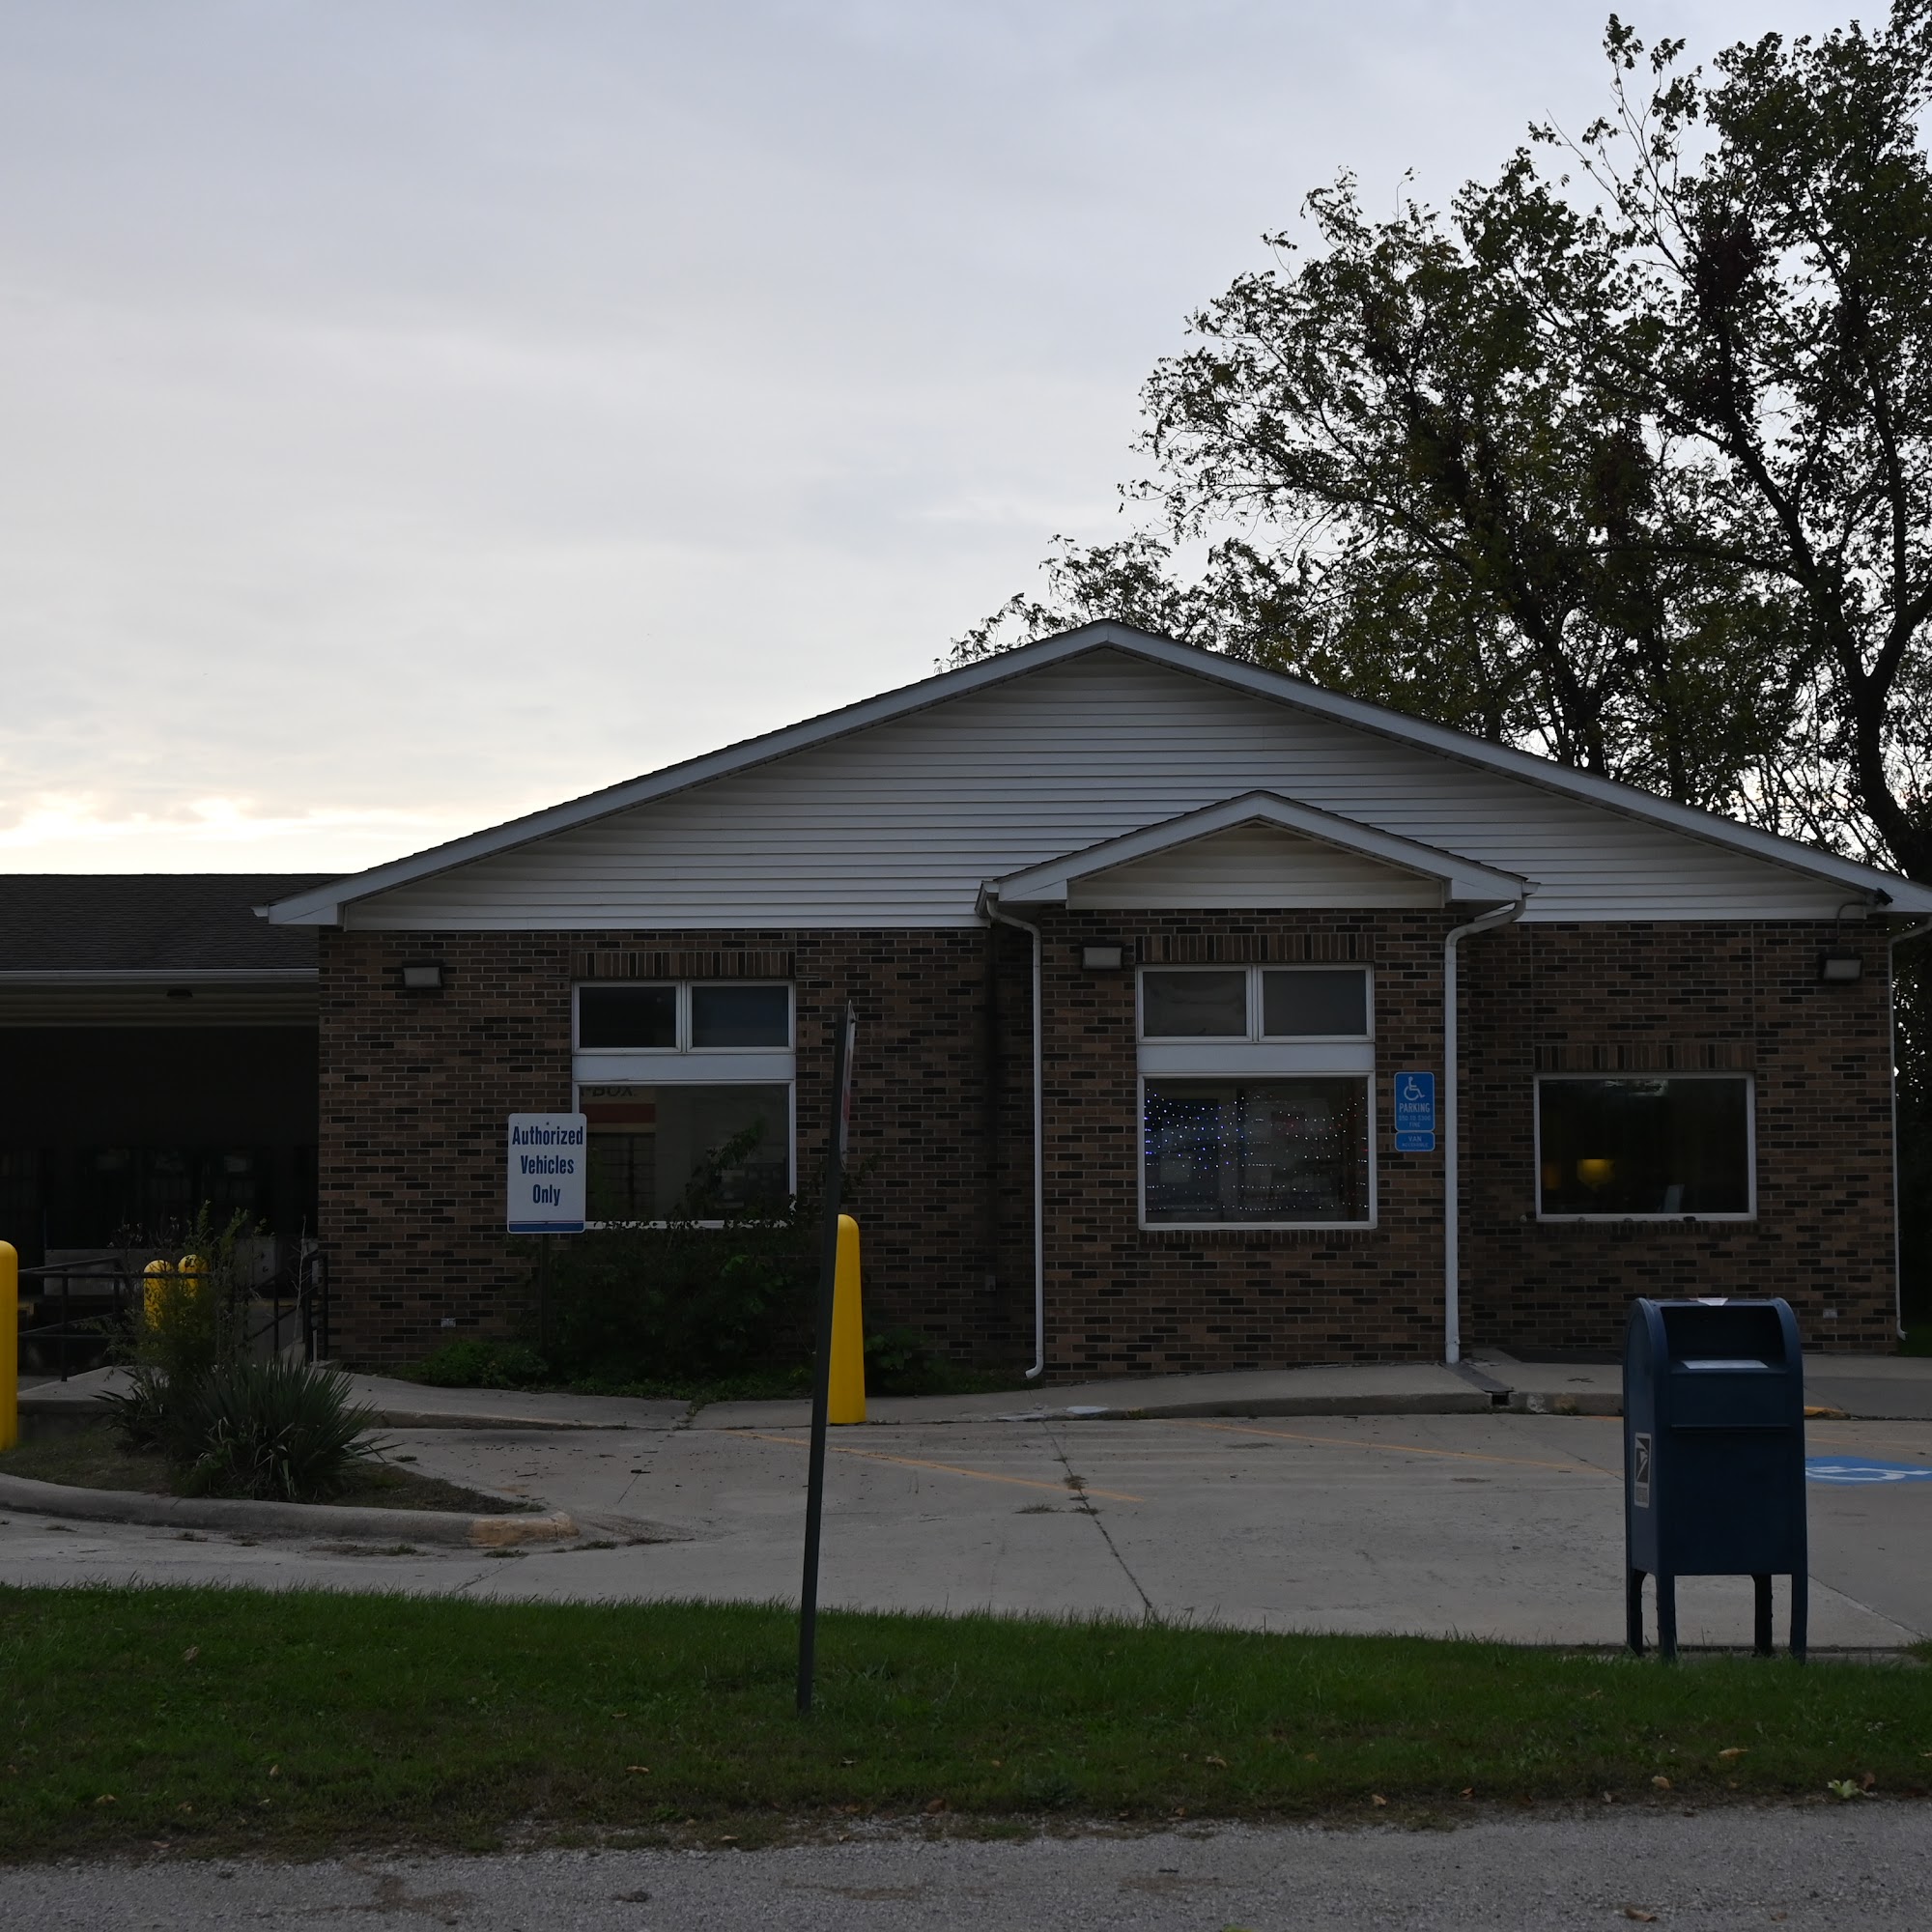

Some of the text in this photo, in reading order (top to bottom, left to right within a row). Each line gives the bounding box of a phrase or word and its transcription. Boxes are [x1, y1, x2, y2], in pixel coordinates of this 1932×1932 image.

[1399, 1102, 1431, 1113] PARKING
[512, 1125, 583, 1146] Authorized
[521, 1154, 575, 1175] Vehicles
[532, 1183, 560, 1207] Only
